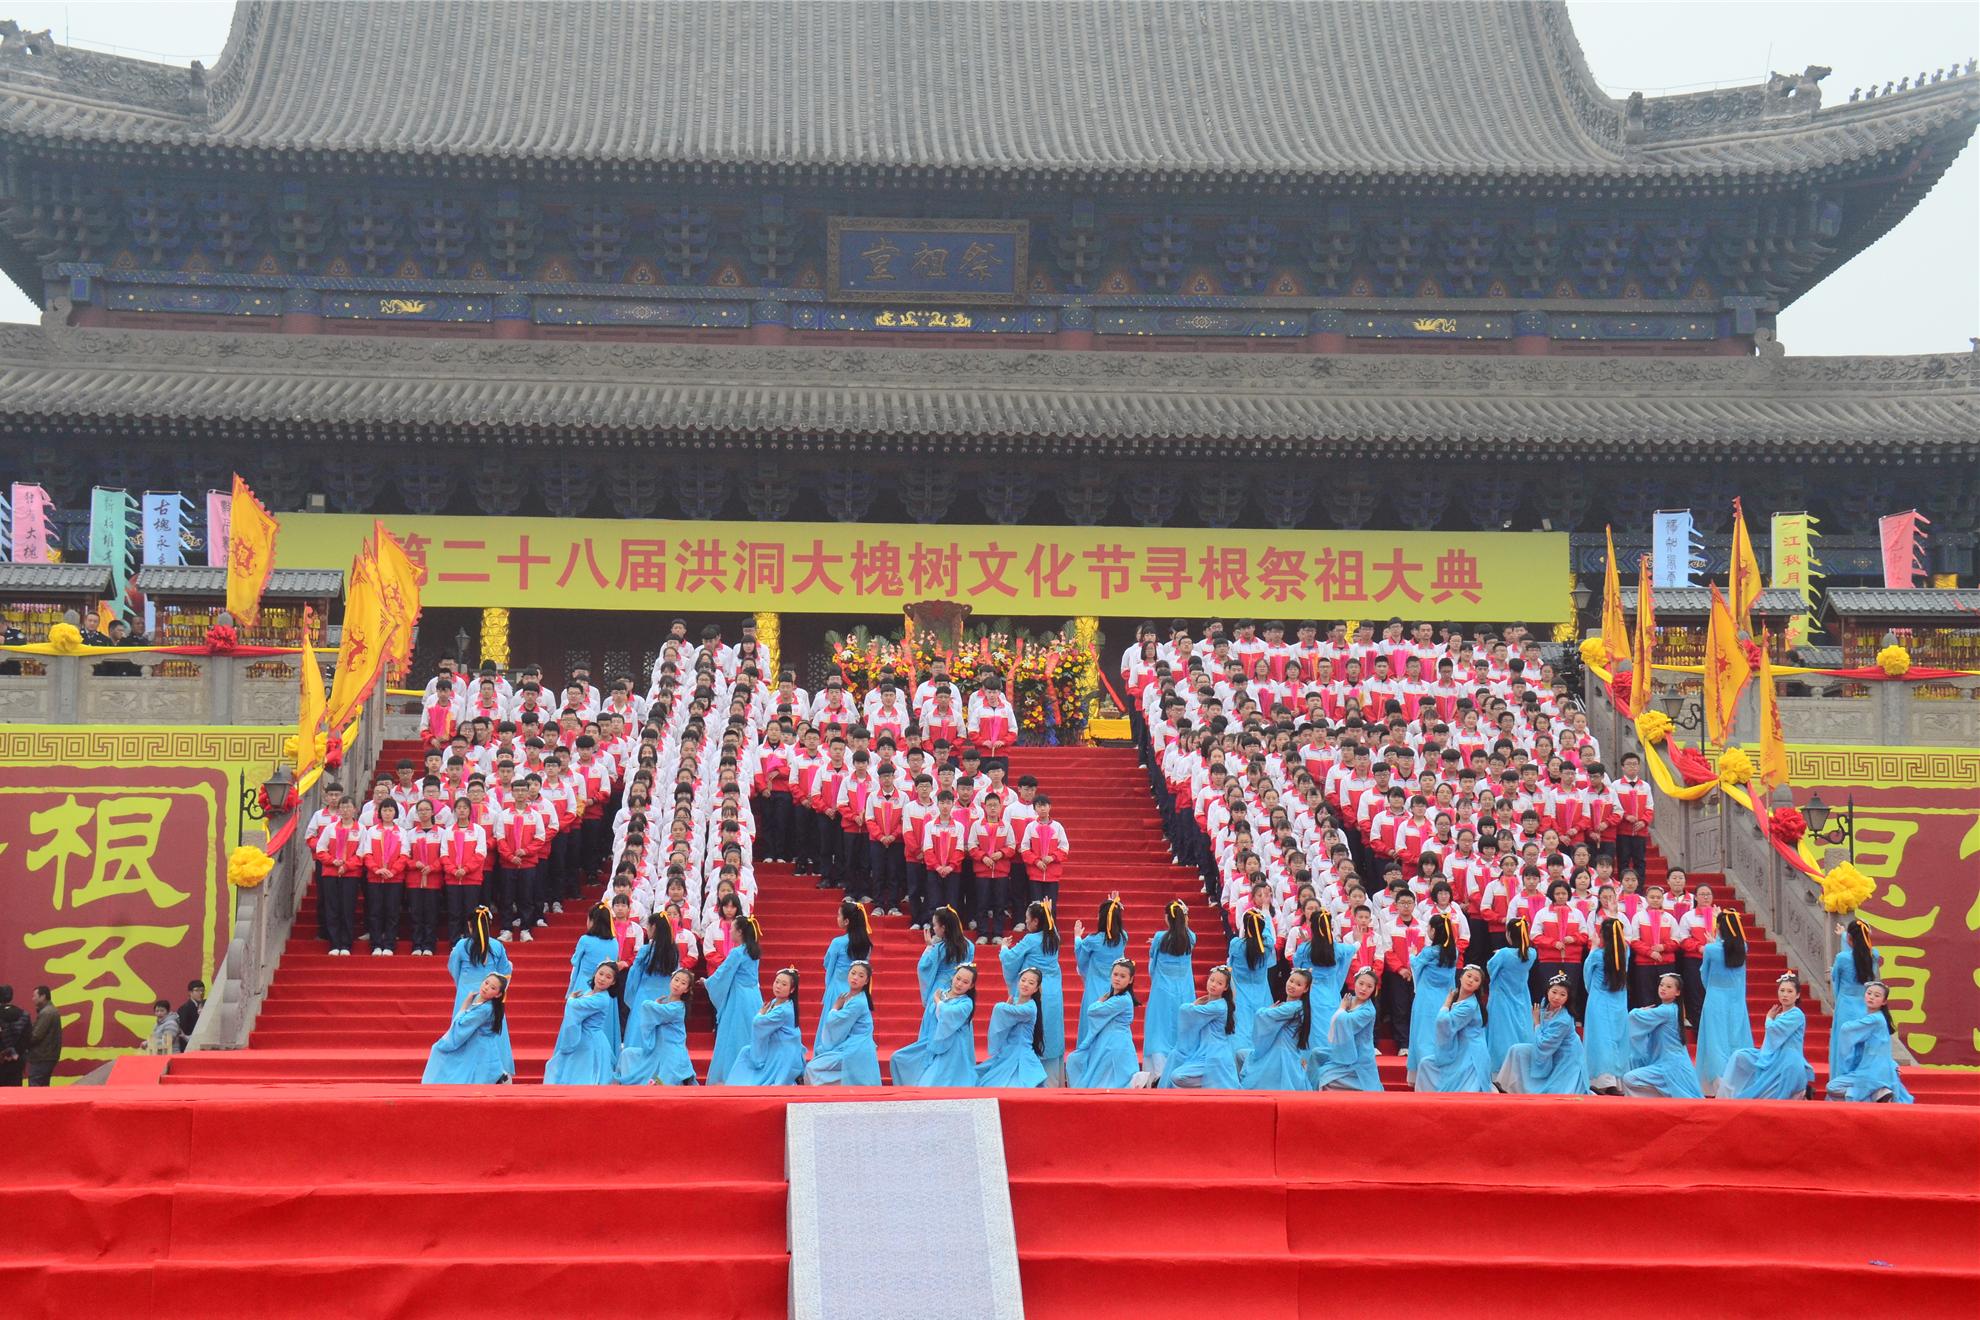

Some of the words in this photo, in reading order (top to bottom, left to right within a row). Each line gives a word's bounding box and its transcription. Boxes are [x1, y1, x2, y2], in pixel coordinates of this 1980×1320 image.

[386, 531, 1483, 604] 第二十八届洪洞大槐树文化节寻根祭祖大典
